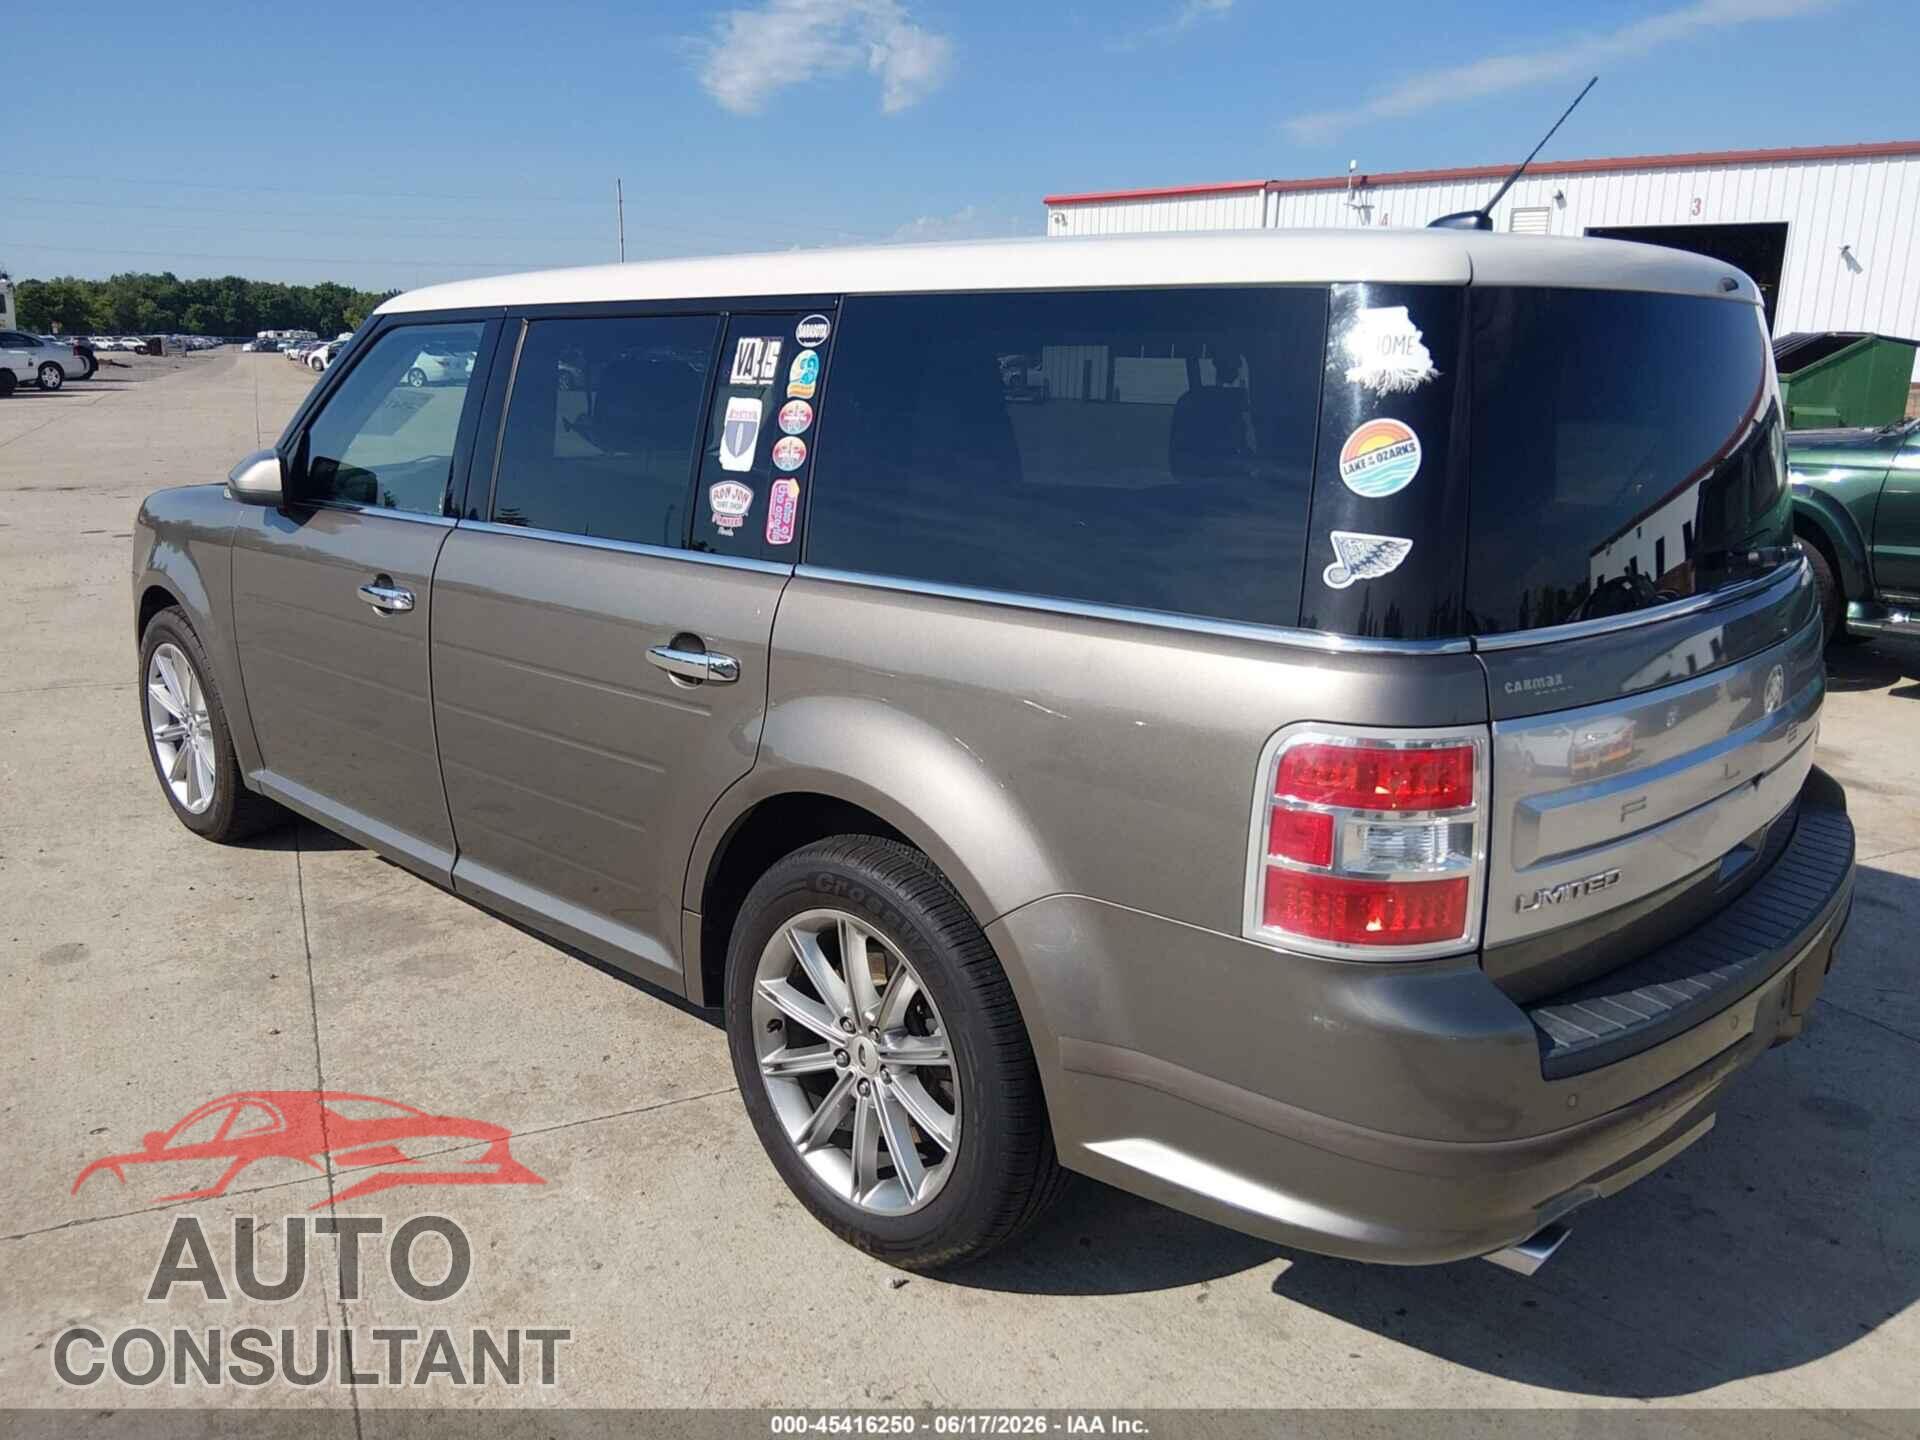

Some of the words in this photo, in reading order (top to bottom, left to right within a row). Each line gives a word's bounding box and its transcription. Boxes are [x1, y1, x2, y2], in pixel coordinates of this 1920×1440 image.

[1692, 197, 1702, 217] 3
[1343, 458, 1367, 476] LAKE
[1375, 442, 1417, 464] OZARKS
[1514, 868, 1623, 914] LIMITED
